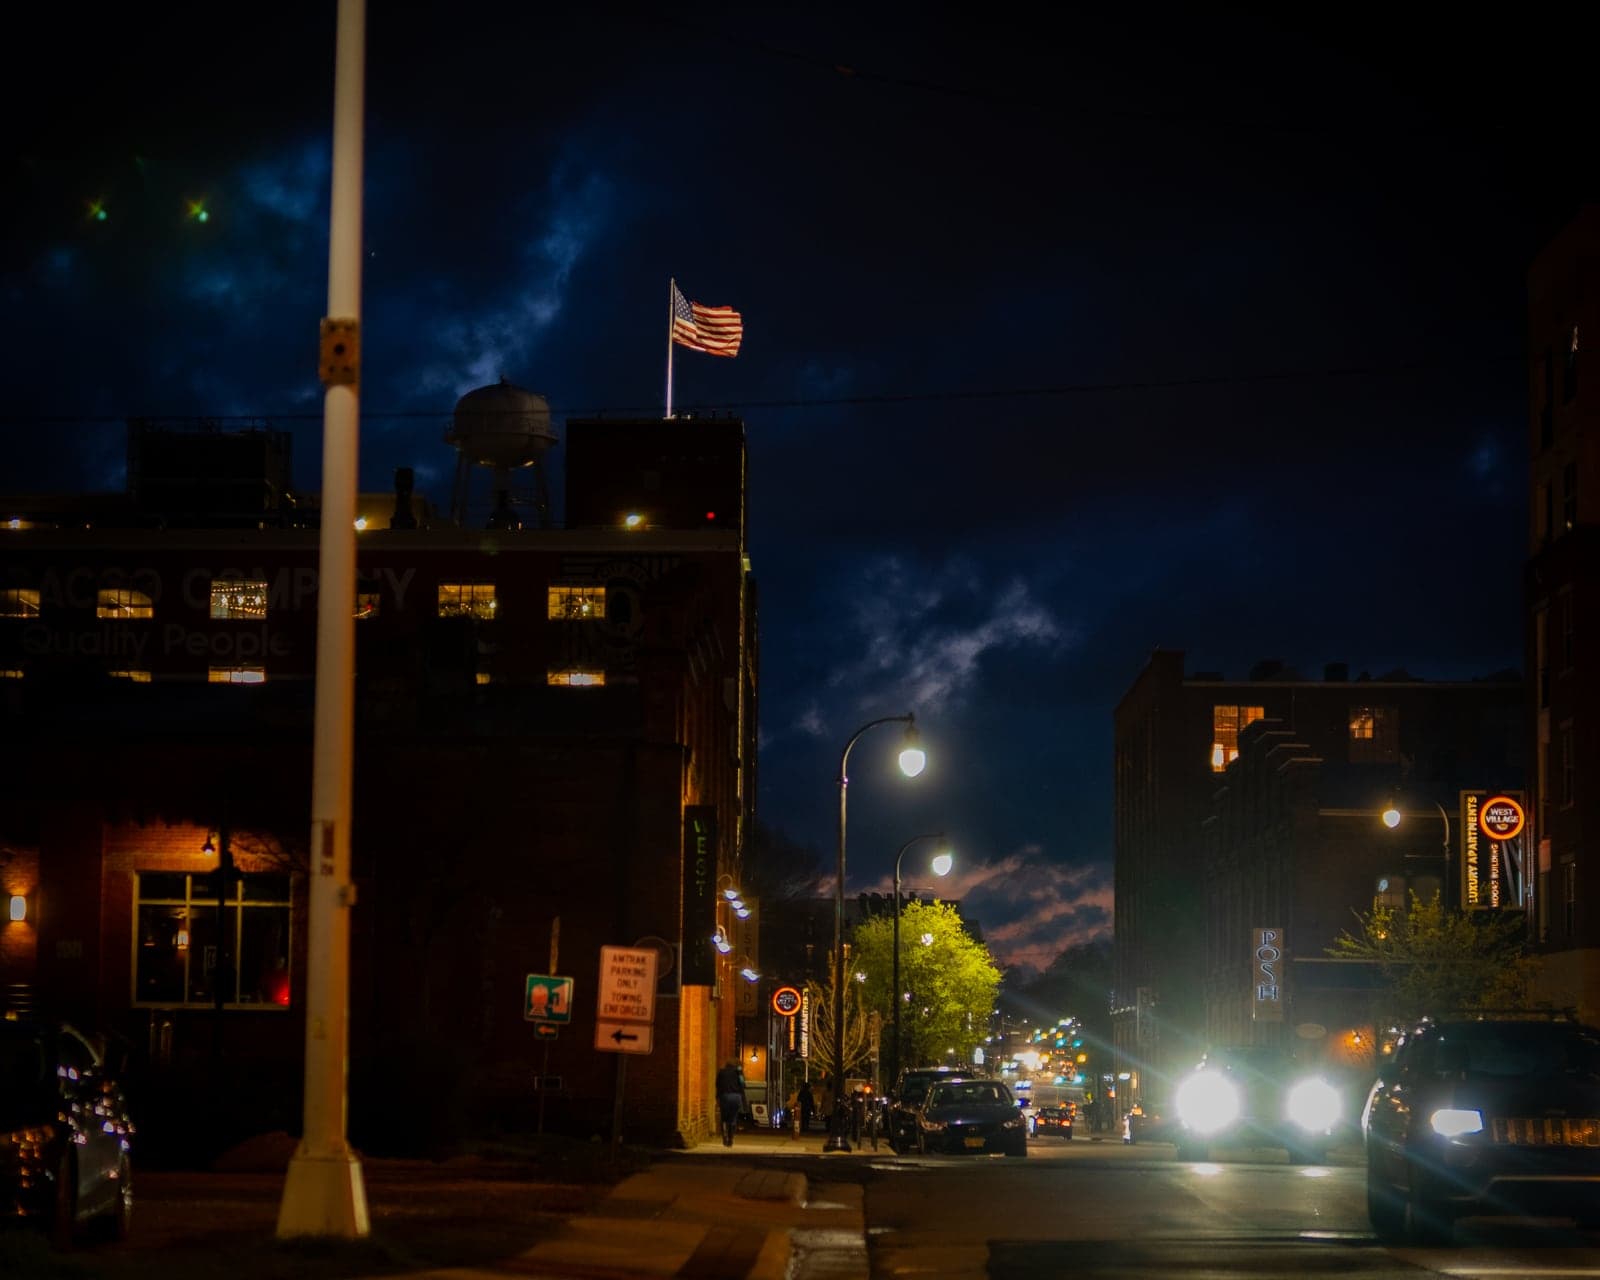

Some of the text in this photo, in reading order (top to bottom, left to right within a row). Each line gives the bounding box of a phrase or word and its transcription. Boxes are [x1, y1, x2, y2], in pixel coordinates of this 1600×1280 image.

[22, 623, 289, 661] Quality People
[1489, 807, 1514, 816] WEST
[1485, 815, 1519, 824] VILLAGE
[1467, 795, 1479, 904] LUXURY APARTMENTS
[1490, 842, 1500, 880] BUILDING
[612, 953, 646, 965] AMTRAK
[1256, 930, 1281, 1001] POSH
[610, 965, 647, 978] PARKING
[616, 978, 638, 989] ONLY
[612, 992, 642, 1003] TOWING
[603, 1003, 648, 1016] ENFORCED
